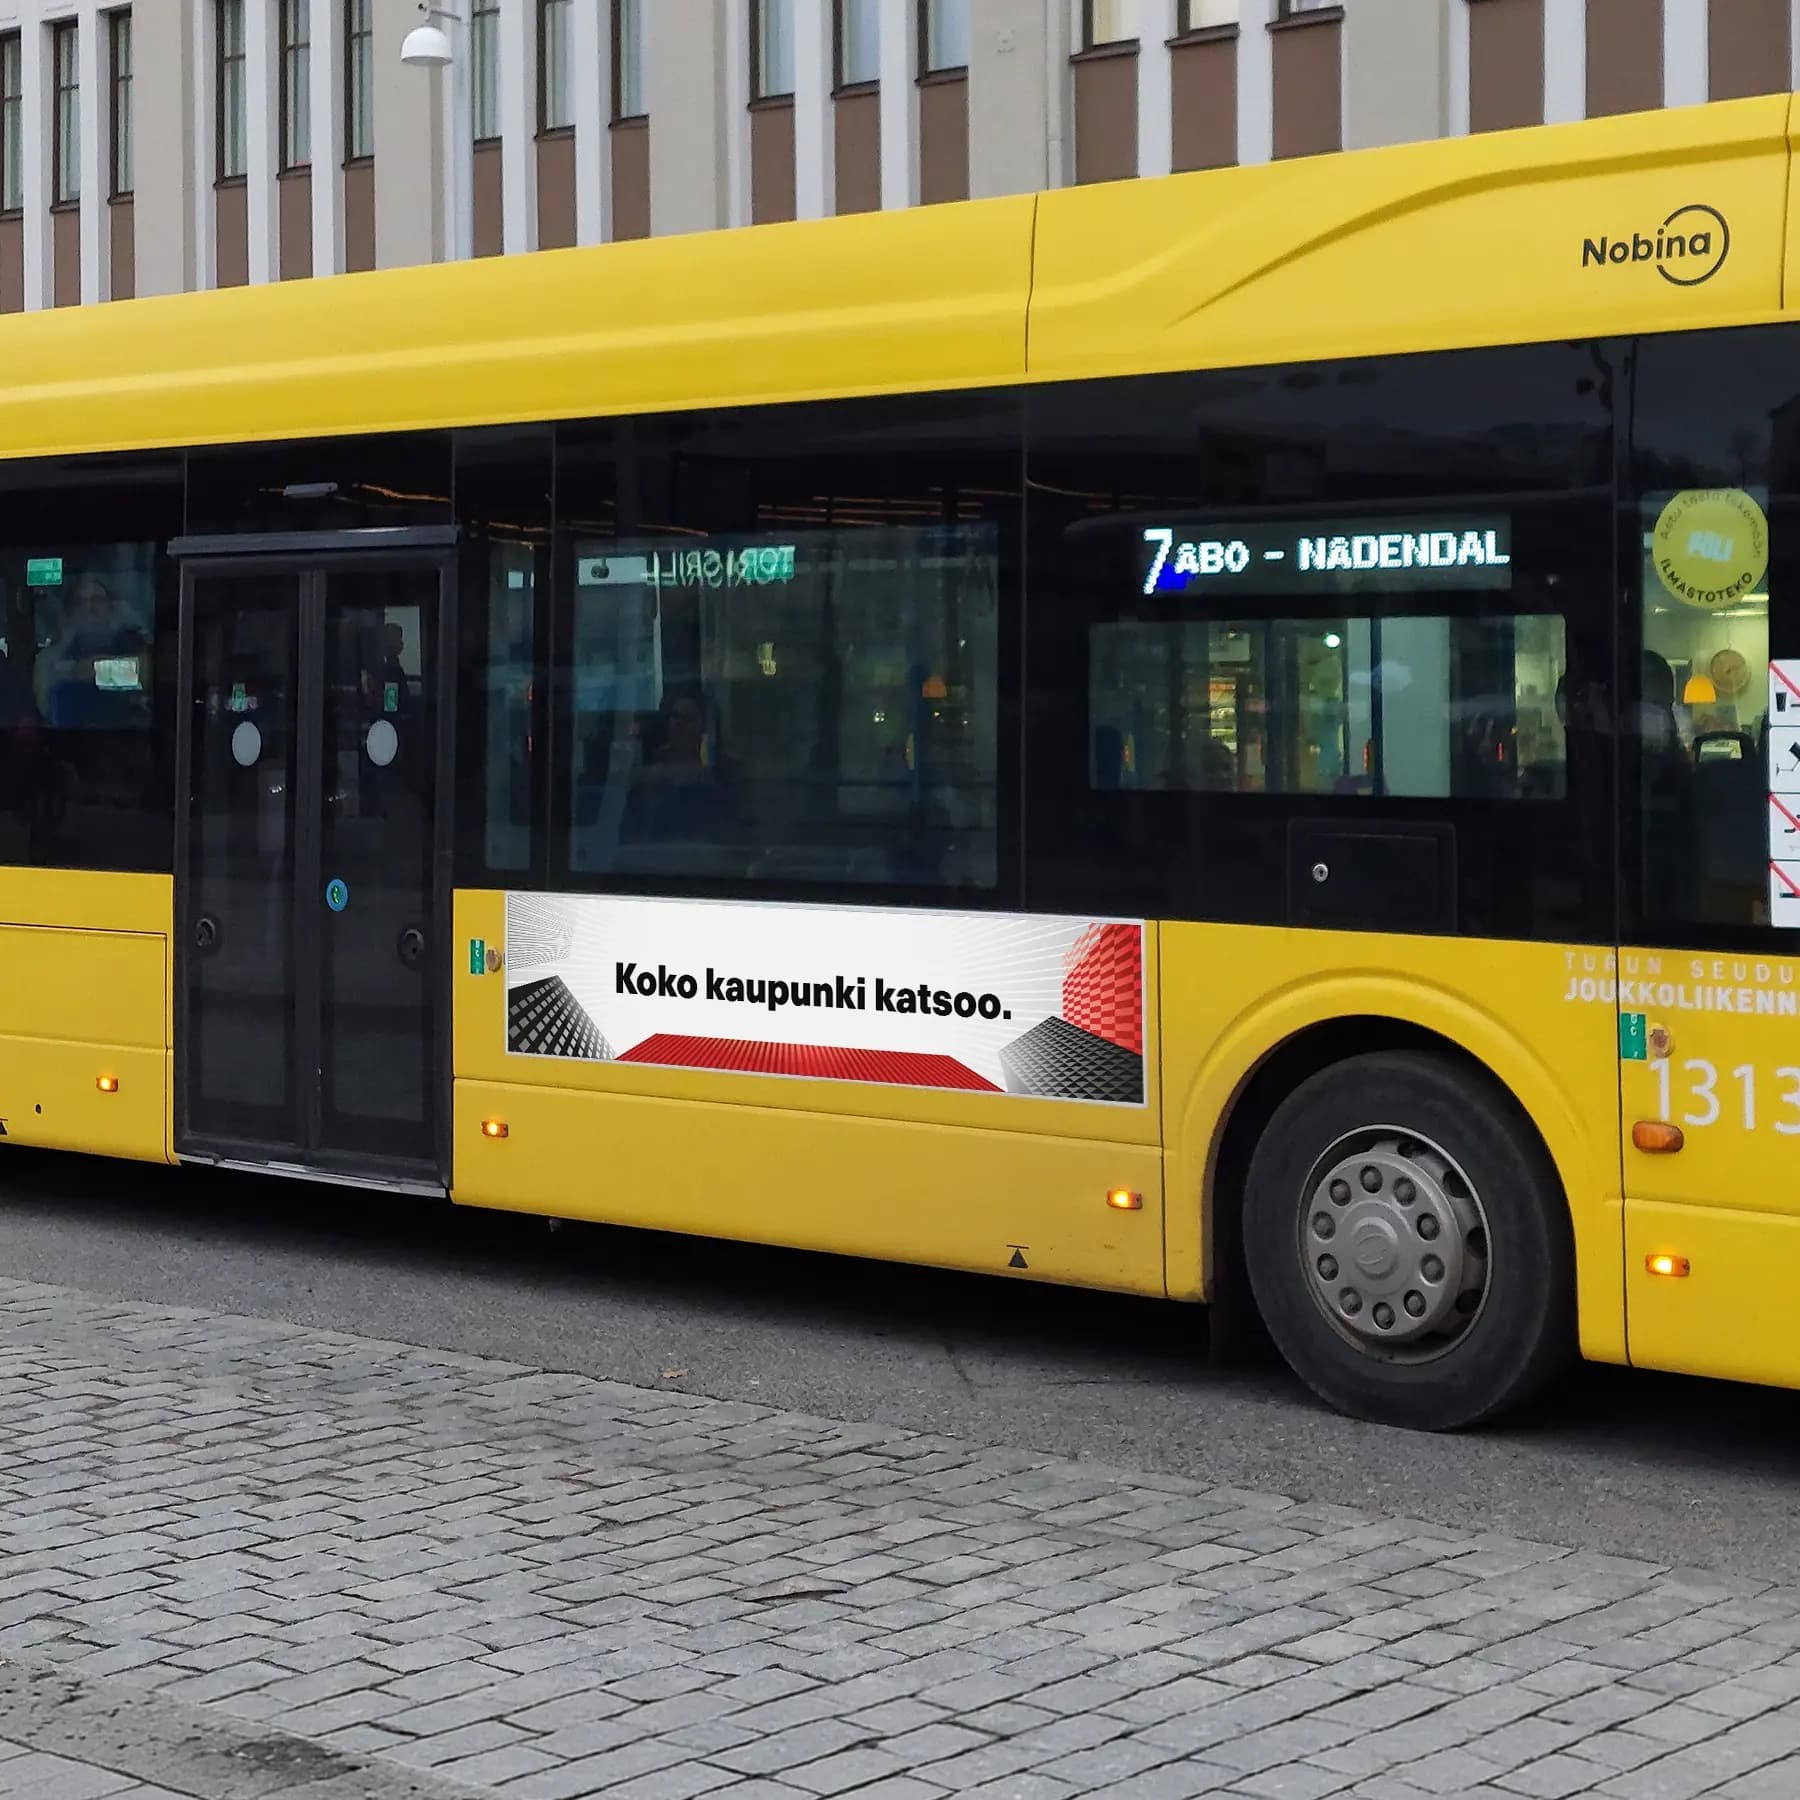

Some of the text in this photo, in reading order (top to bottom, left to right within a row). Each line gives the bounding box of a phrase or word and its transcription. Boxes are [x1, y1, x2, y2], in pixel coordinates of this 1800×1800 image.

[1582, 228, 1712, 267] Nobina
[1143, 528, 1173, 595] 7
[1660, 558, 1753, 603] ILMASTOTEKO
[615, 962, 1012, 1020] Koko kaupunki katsoo.
[1564, 952, 1793, 984] TURUN SEUDU
[1649, 1058, 1800, 1134] 1313
